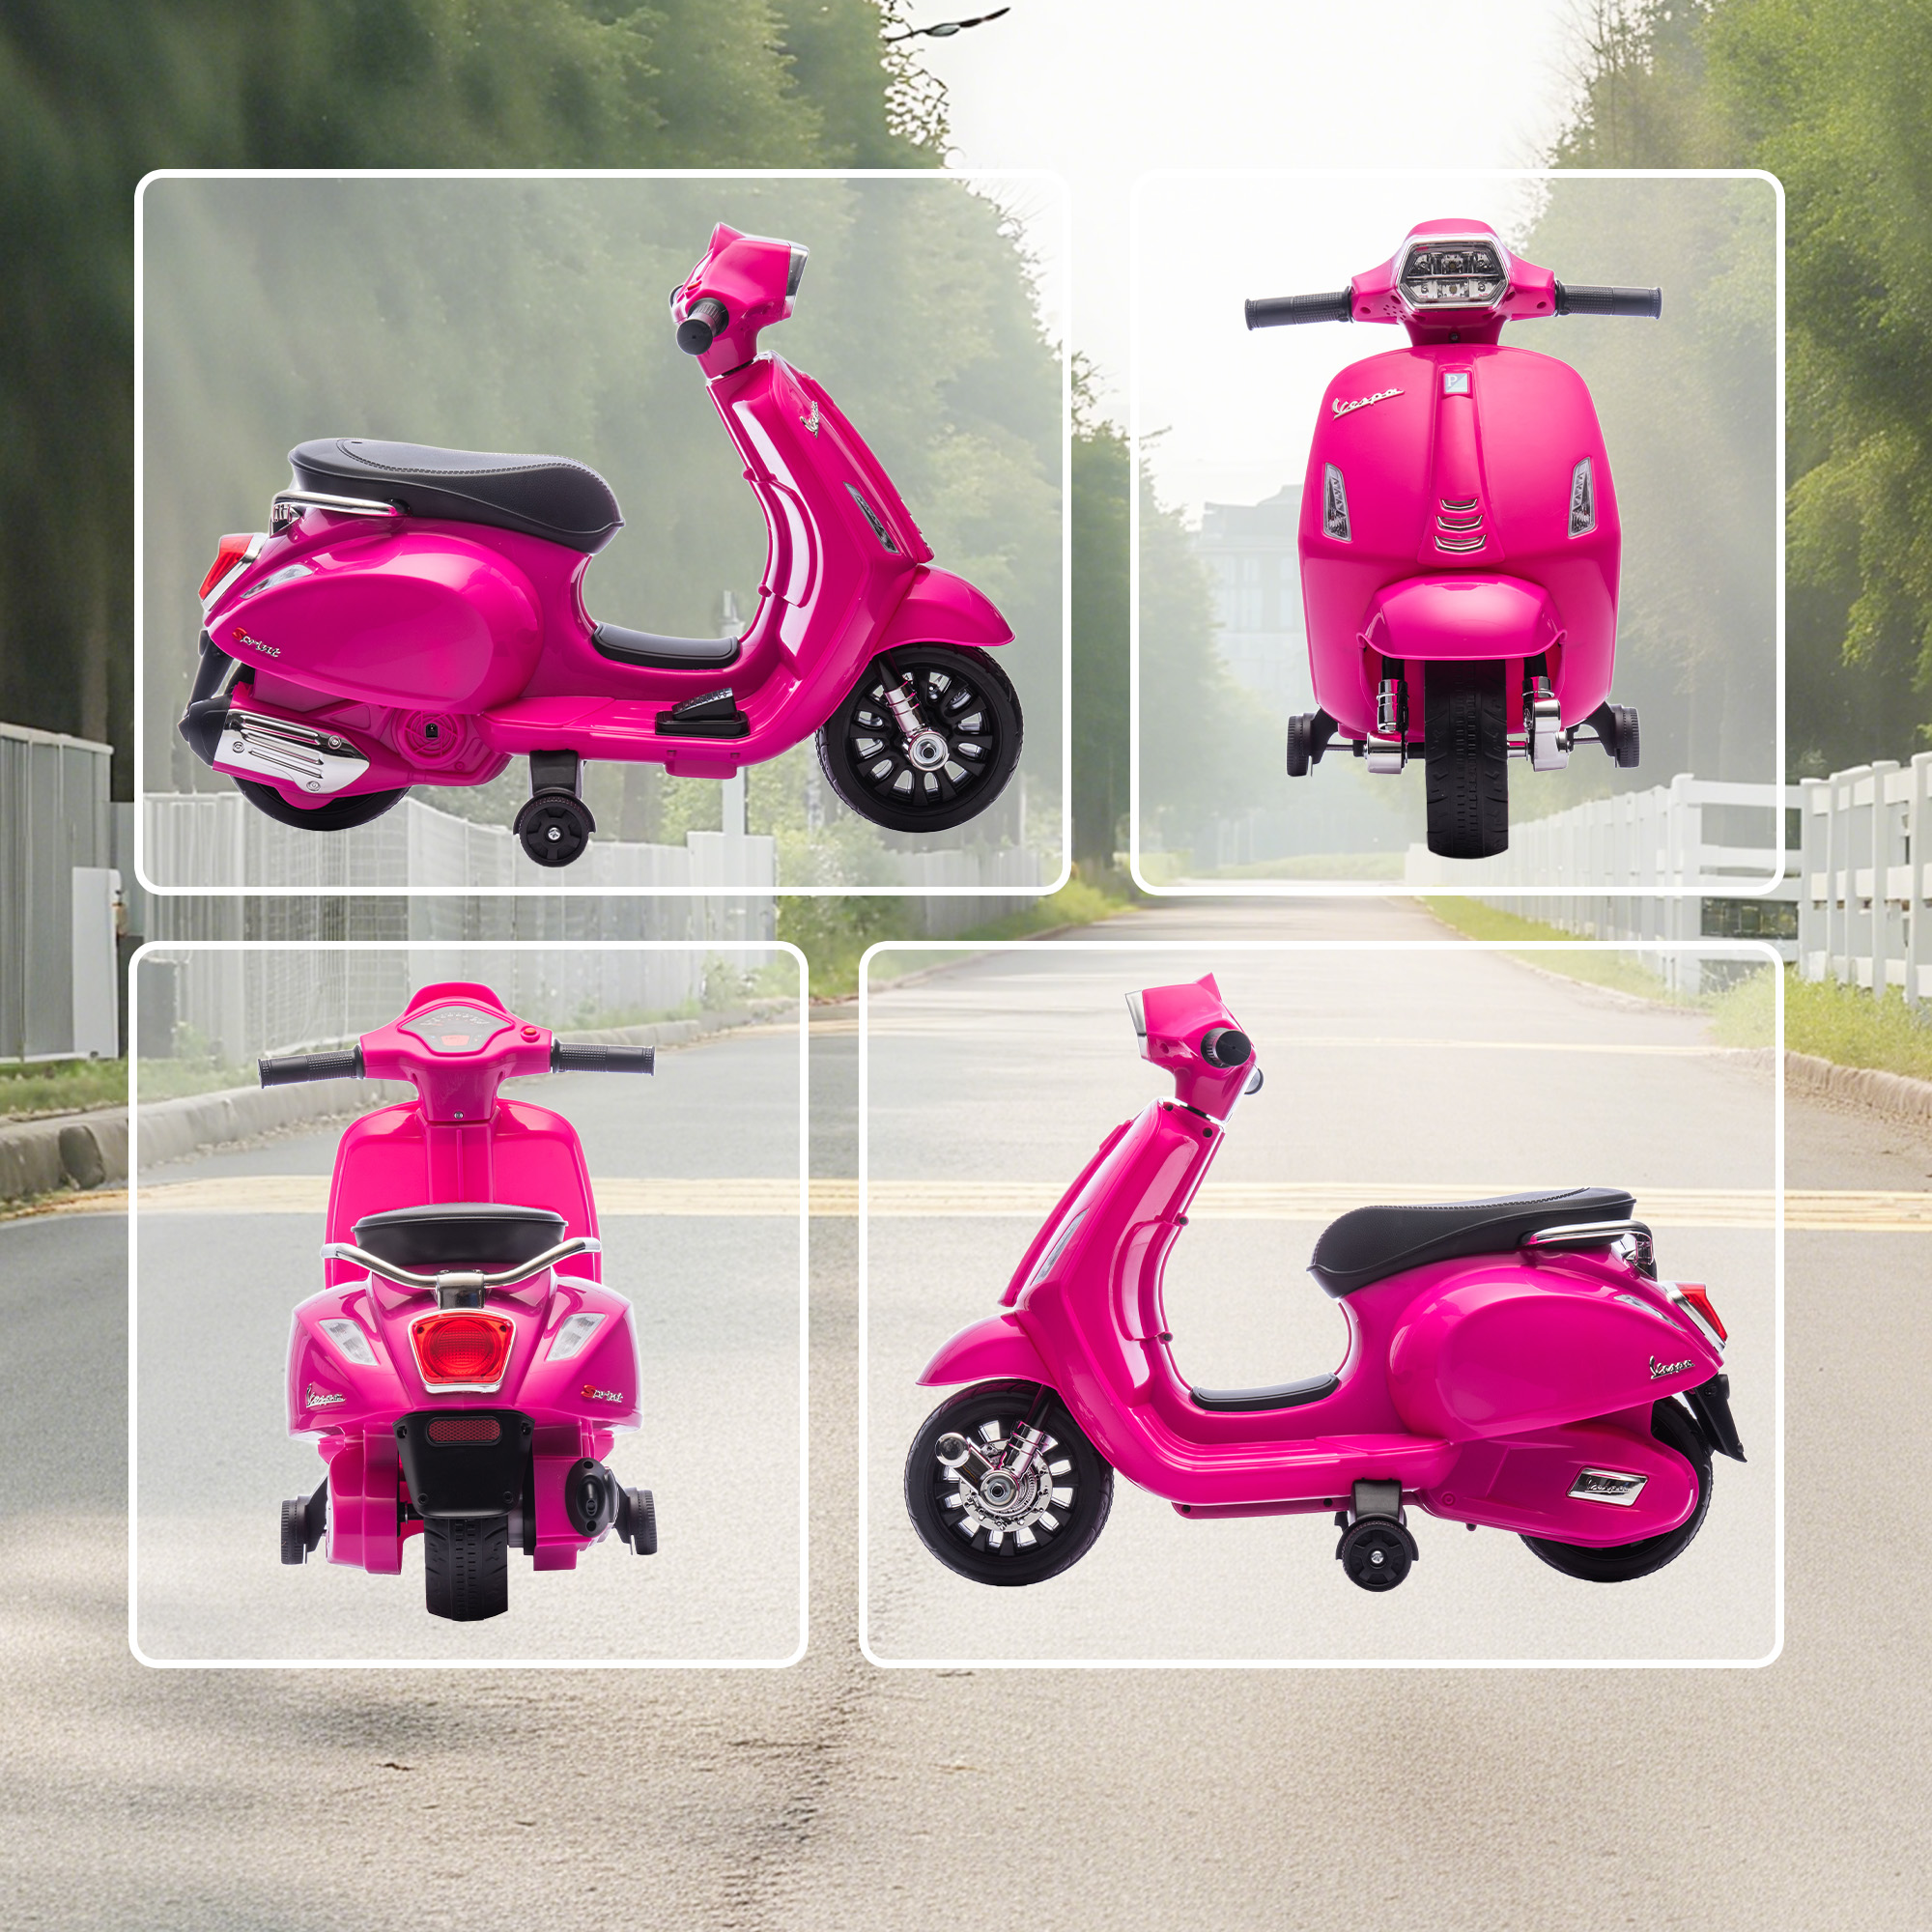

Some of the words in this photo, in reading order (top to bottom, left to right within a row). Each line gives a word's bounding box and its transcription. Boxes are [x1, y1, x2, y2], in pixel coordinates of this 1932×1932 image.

[1447, 375, 1458, 387] P
[1332, 388, 1405, 419] Vespa
[1650, 1355, 1695, 1379] Vespa
